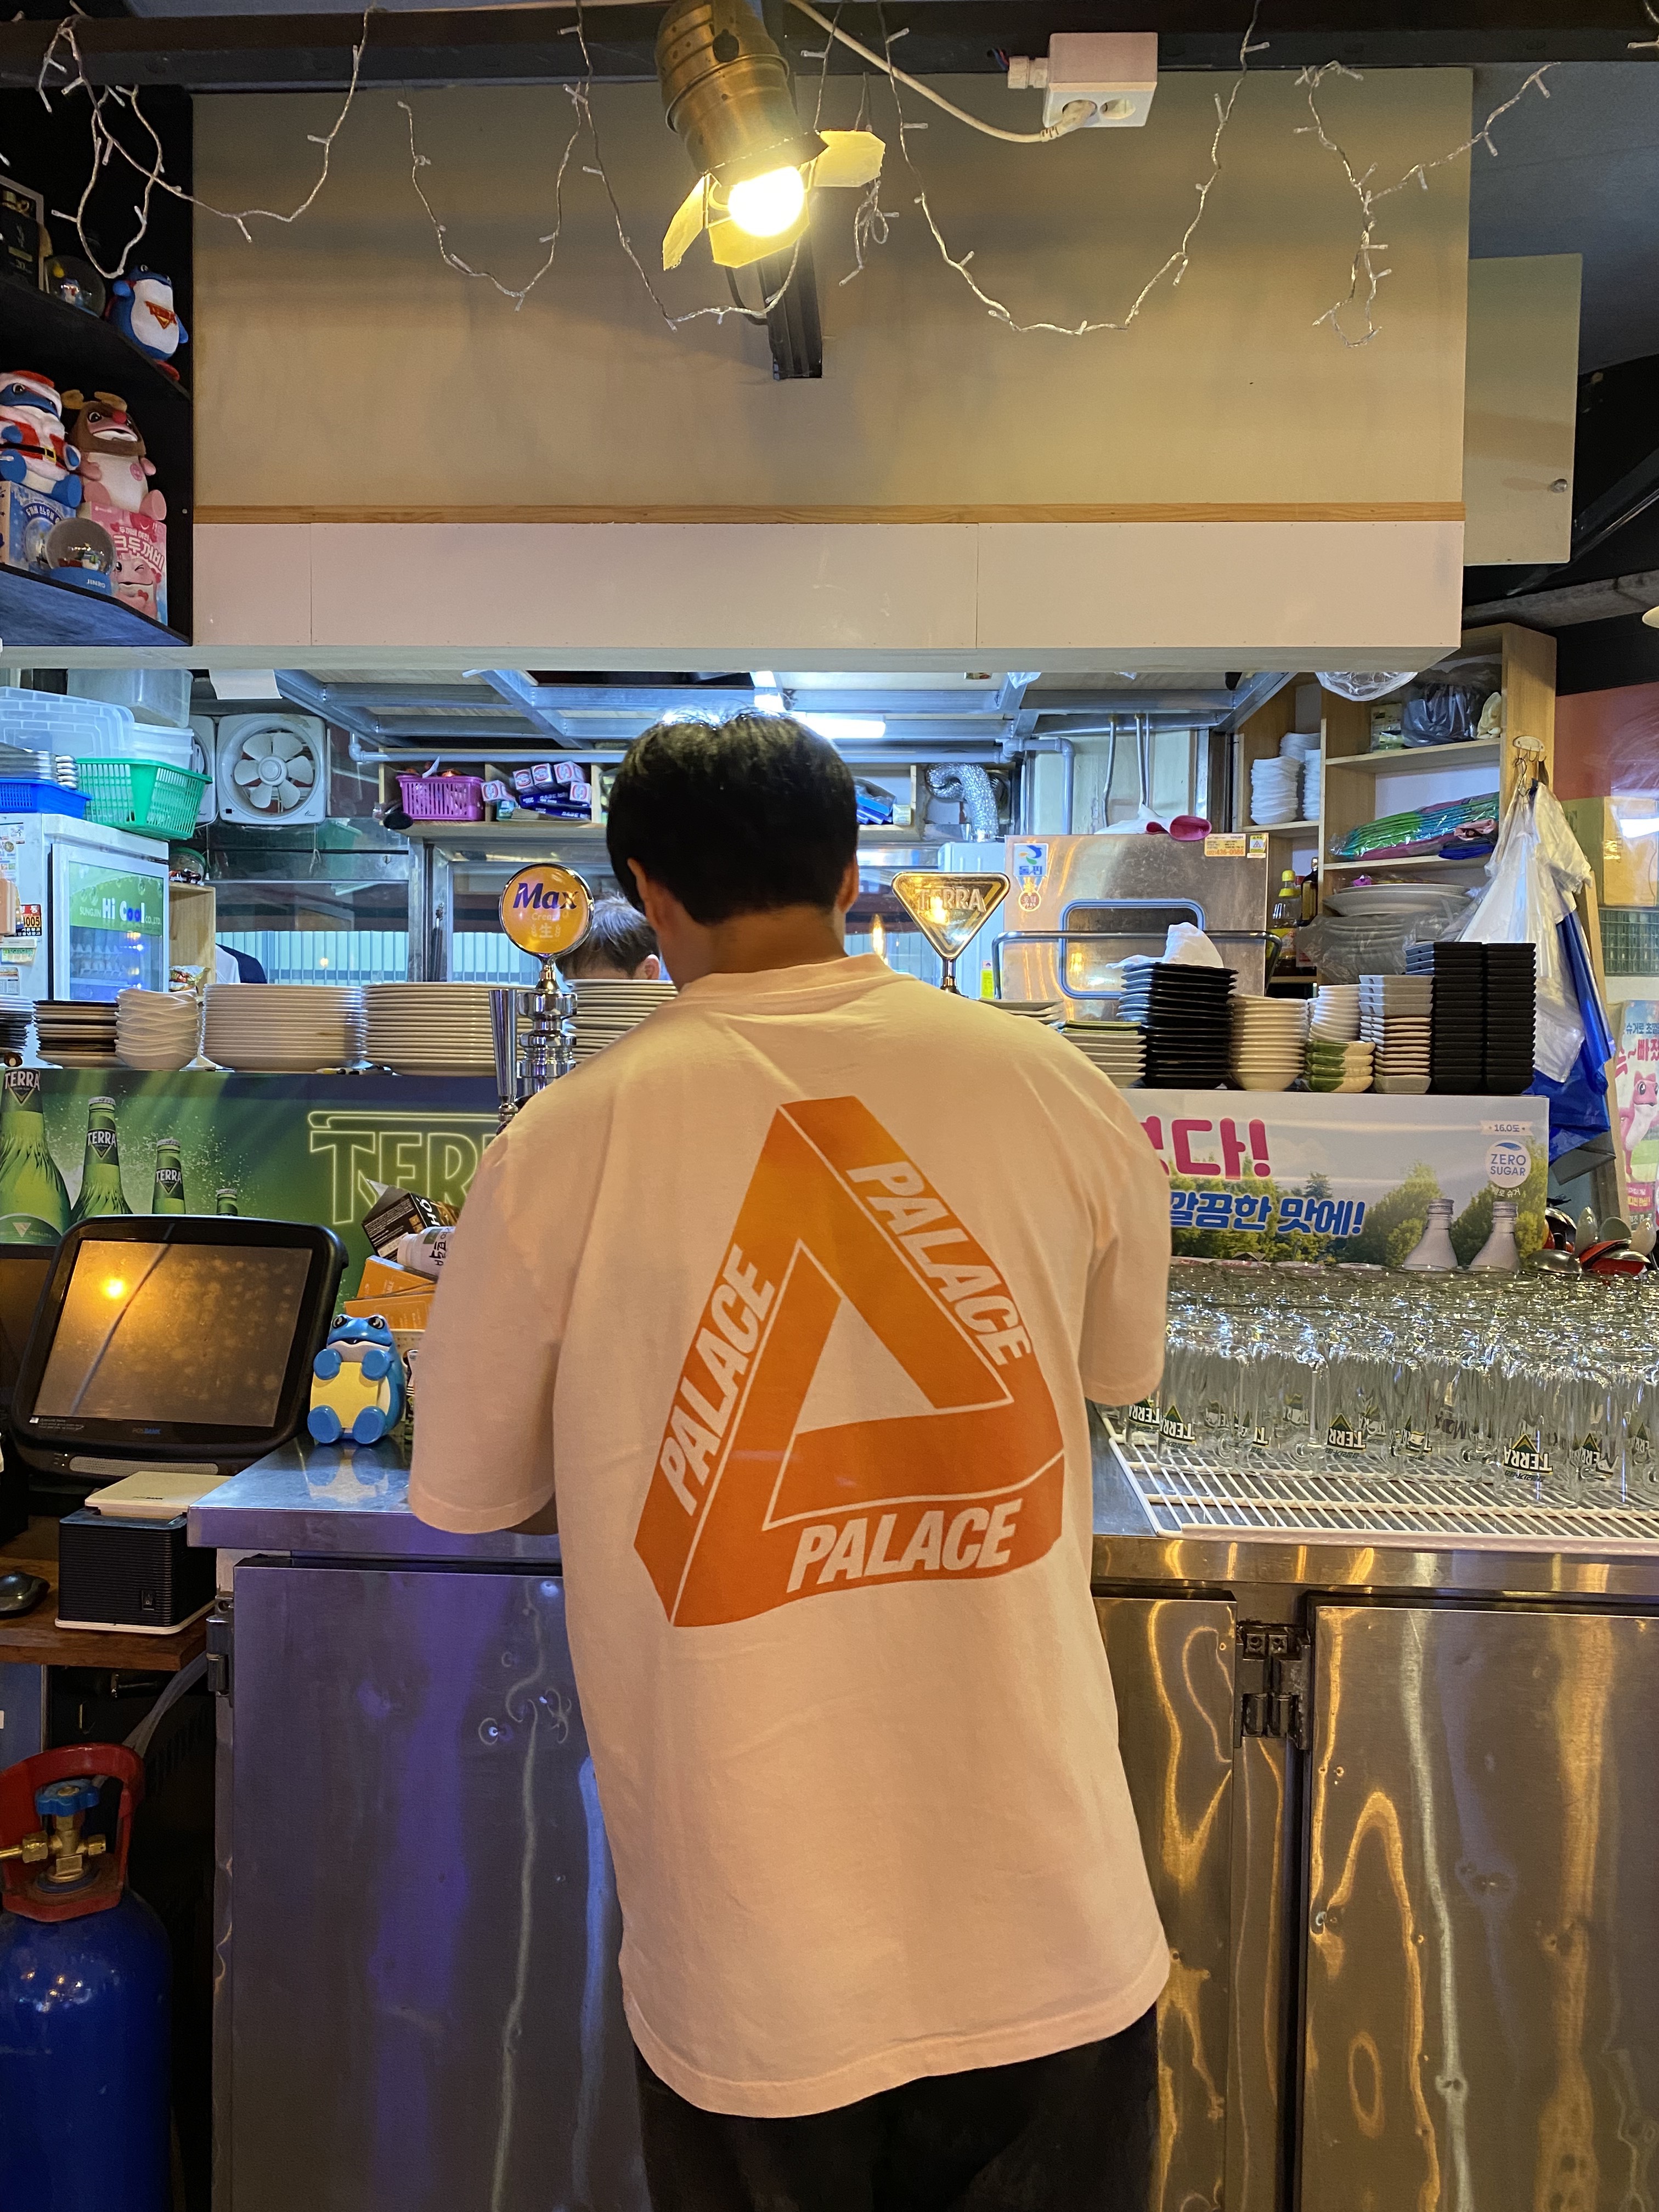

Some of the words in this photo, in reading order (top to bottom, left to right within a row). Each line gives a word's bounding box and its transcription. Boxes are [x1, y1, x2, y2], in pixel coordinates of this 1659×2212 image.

[87, 578, 106, 588] JINRO
[512, 883, 579, 909] Max
[80, 906, 101, 917] SUNGJIN
[102, 898, 115, 919] Hi
[120, 900, 145, 923] Cool
[532, 912, 560, 922] Crea
[5, 1070, 41, 1092] TERRA
[1494, 1124, 1520, 1132] 16.0도
[88, 1131, 116, 1148] TERRA
[1491, 1153, 1526, 1166] ZERO
[156, 1169, 182, 1184] TERRA
[310, 1130, 497, 1225] TER
[1490, 1166, 1526, 1176] SUGAR
[1507, 1188, 1521, 1198] 슈거
[1278, 1198, 1365, 1235] 맛에!
[845, 1160, 1034, 1366] PALACE
[659, 1242, 775, 1517] PALACE
[1503, 1446, 1553, 1471] TERRA
[786, 1498, 1023, 1593] PALACE
